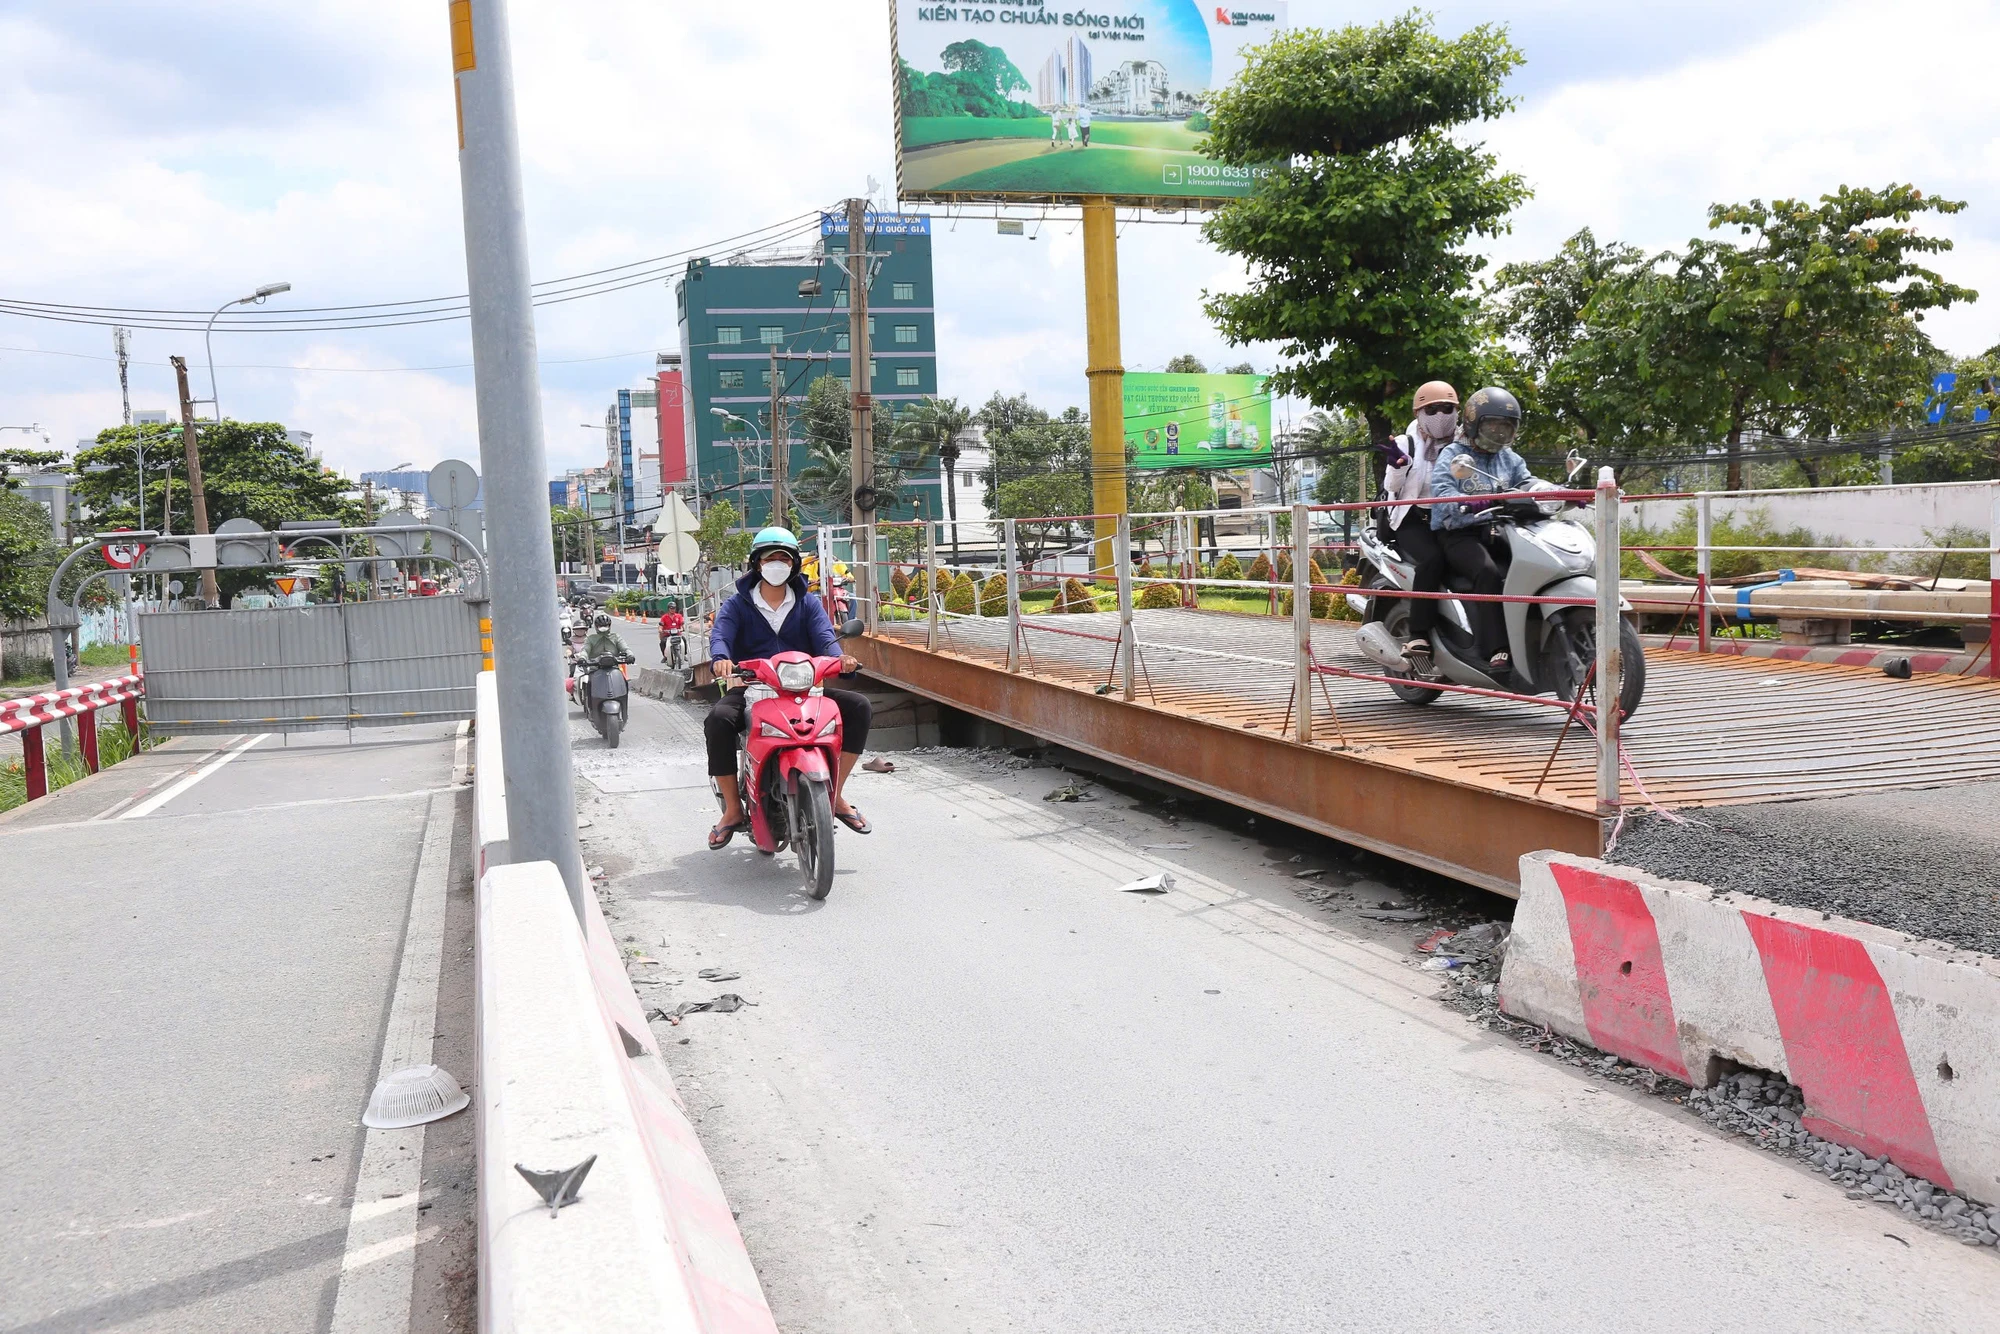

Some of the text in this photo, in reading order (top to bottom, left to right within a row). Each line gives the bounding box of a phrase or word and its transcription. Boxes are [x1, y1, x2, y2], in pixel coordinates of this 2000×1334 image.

[918, 3, 1144, 30] KIẾN TẠO CHUẨN SỐNG MỚI
[1231, 12, 1275, 22] KIM OANH
[1088, 31, 1144, 41] tại Việt Nam
[1186, 165, 1219, 177] 1900
[1222, 166, 1249, 178] 633
[1187, 179, 1250, 188] kimoanhland.vn
[885, 223, 908, 233] QUỐC
[911, 225, 926, 233] GIA
